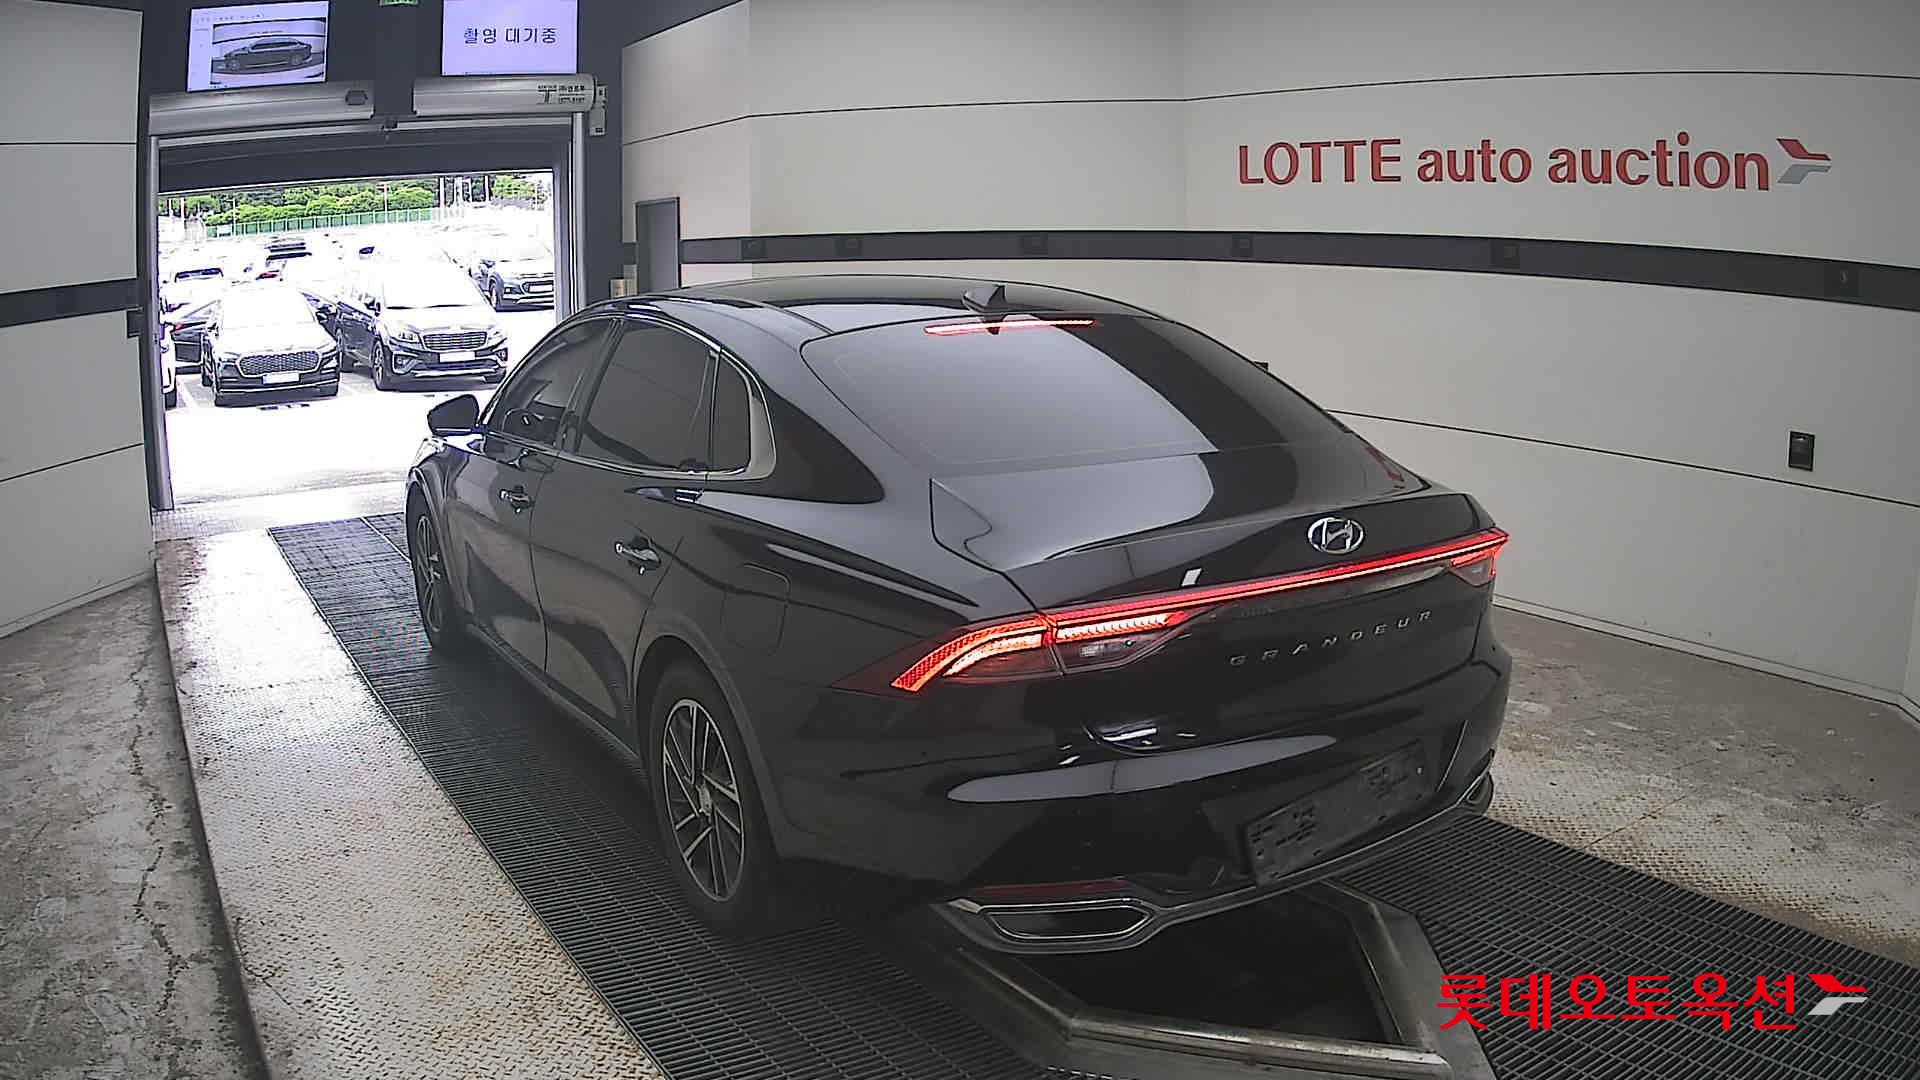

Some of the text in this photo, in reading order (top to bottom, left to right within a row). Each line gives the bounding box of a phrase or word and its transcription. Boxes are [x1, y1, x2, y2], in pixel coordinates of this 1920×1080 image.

[464, 28, 557, 44] 촬영 대기중
[1239, 131, 1770, 191] LOTTE auto auction
[1229, 609, 1431, 666] GRANDEUR
